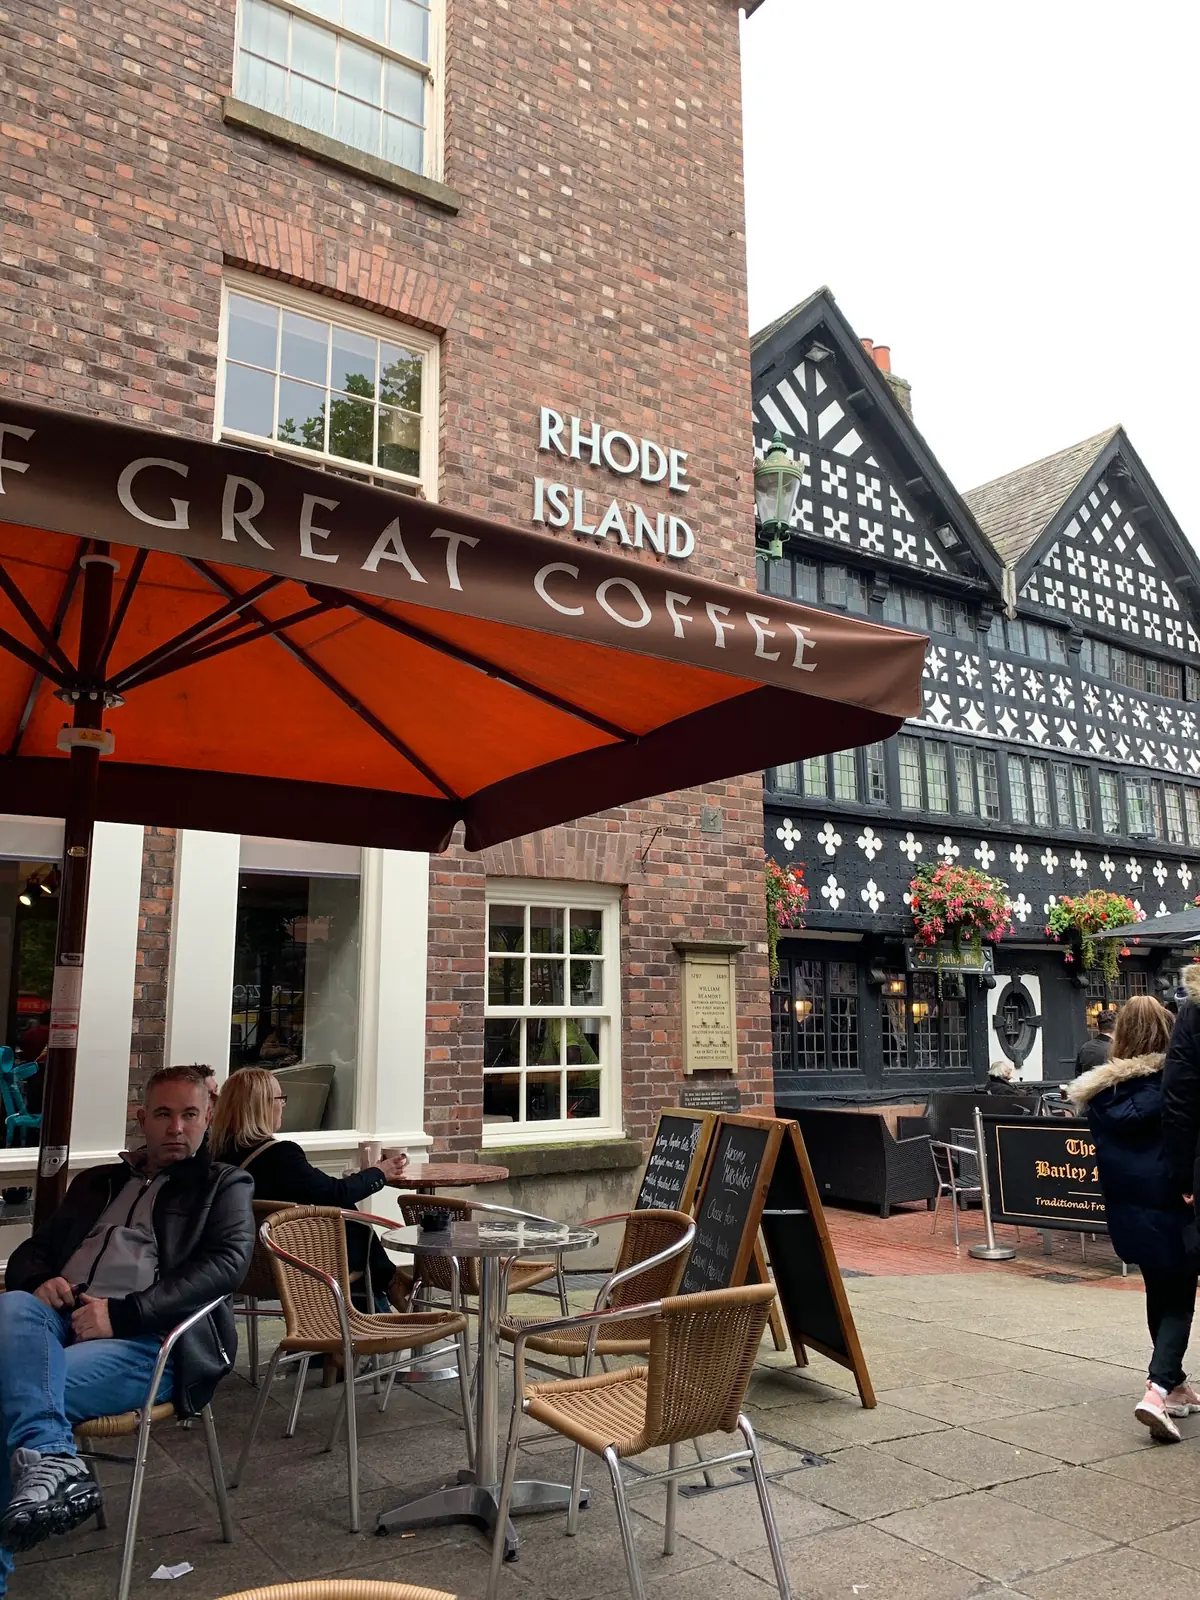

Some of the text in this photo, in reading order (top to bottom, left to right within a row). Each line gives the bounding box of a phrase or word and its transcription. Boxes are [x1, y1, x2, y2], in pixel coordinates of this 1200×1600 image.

[538, 405, 692, 494] RHODE
[531, 476, 696, 560] ISLAND
[116, 456, 482, 593] GREAT
[533, 561, 819, 673] COFFEE
[1035, 1160, 1087, 1183] Barley
[1065, 1138, 1096, 1159] The
[1035, 1196, 1091, 1210] Traditional
